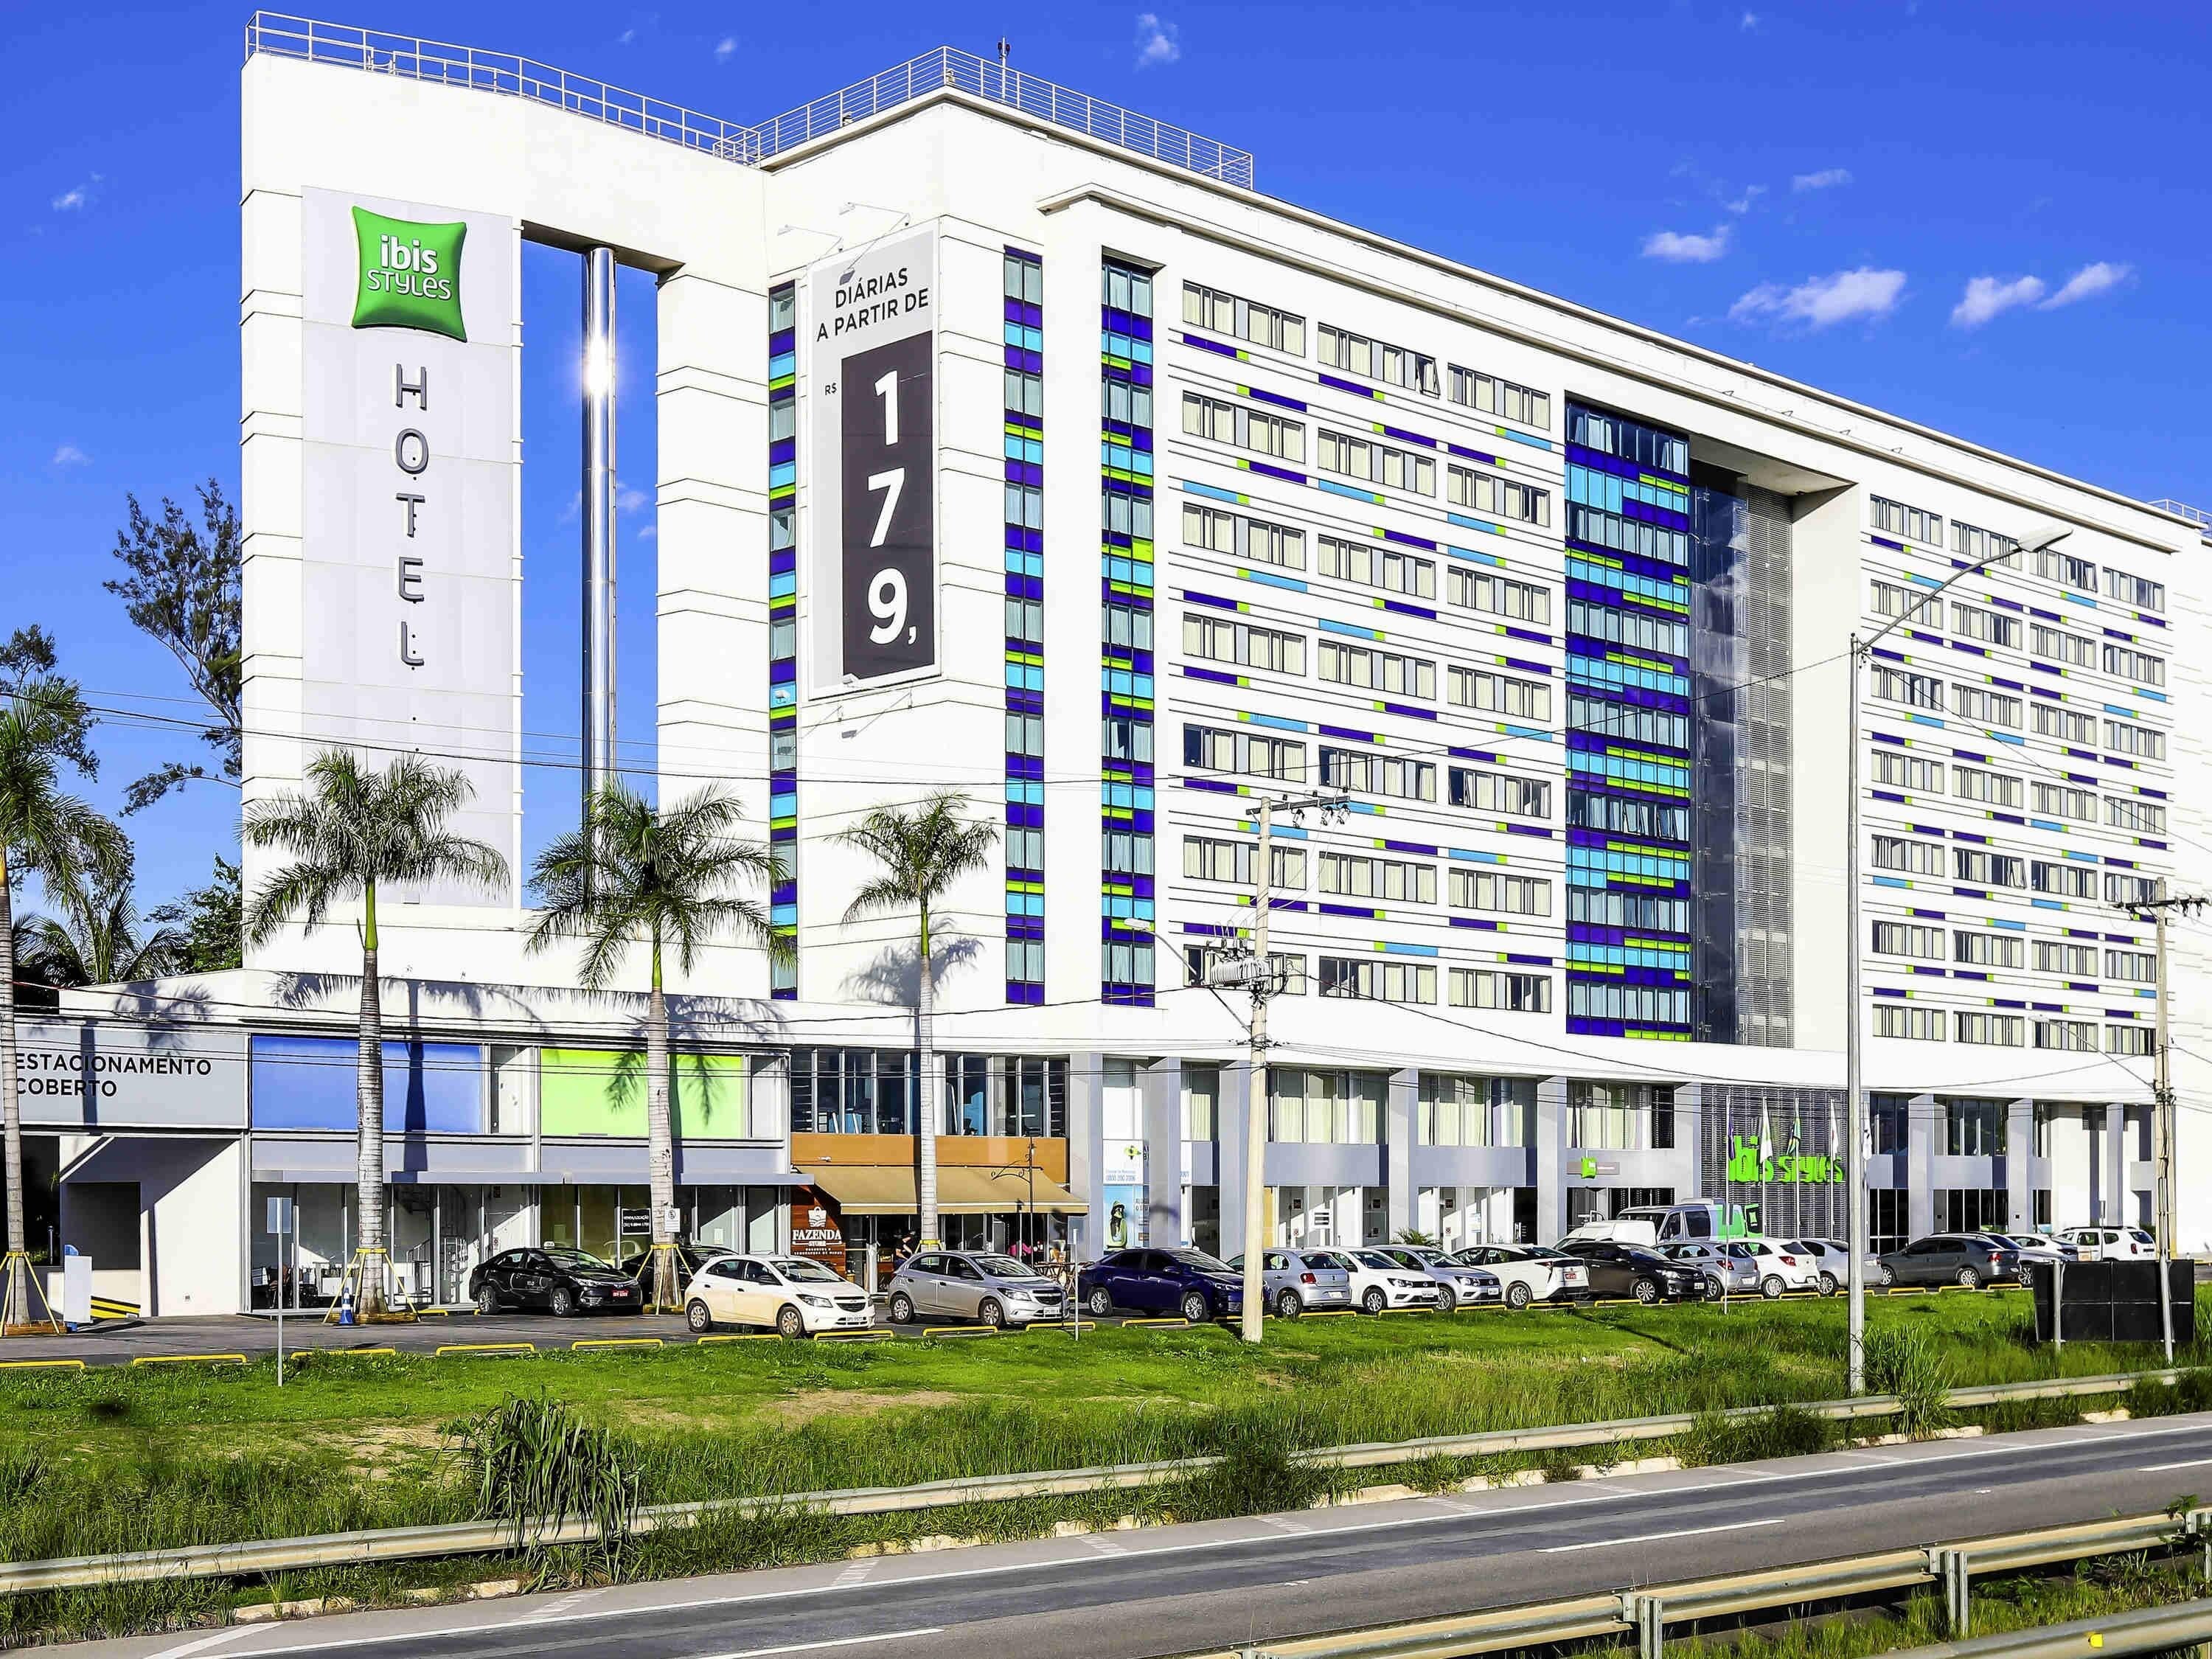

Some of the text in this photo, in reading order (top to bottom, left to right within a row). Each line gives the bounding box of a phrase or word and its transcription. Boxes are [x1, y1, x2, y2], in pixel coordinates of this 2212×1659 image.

[380, 234, 439, 275] ibis
[835, 267, 908, 308] DIÁRIAS
[816, 288, 929, 342] A PARTIR DE
[824, 382, 838, 396] R$
[395, 363, 429, 667] HOTEL
[16, 1053, 212, 1075] ESTACIONAMENTO
[18, 1077, 117, 1096] COBERTO
[792, 1229, 842, 1240] FAZENDA
